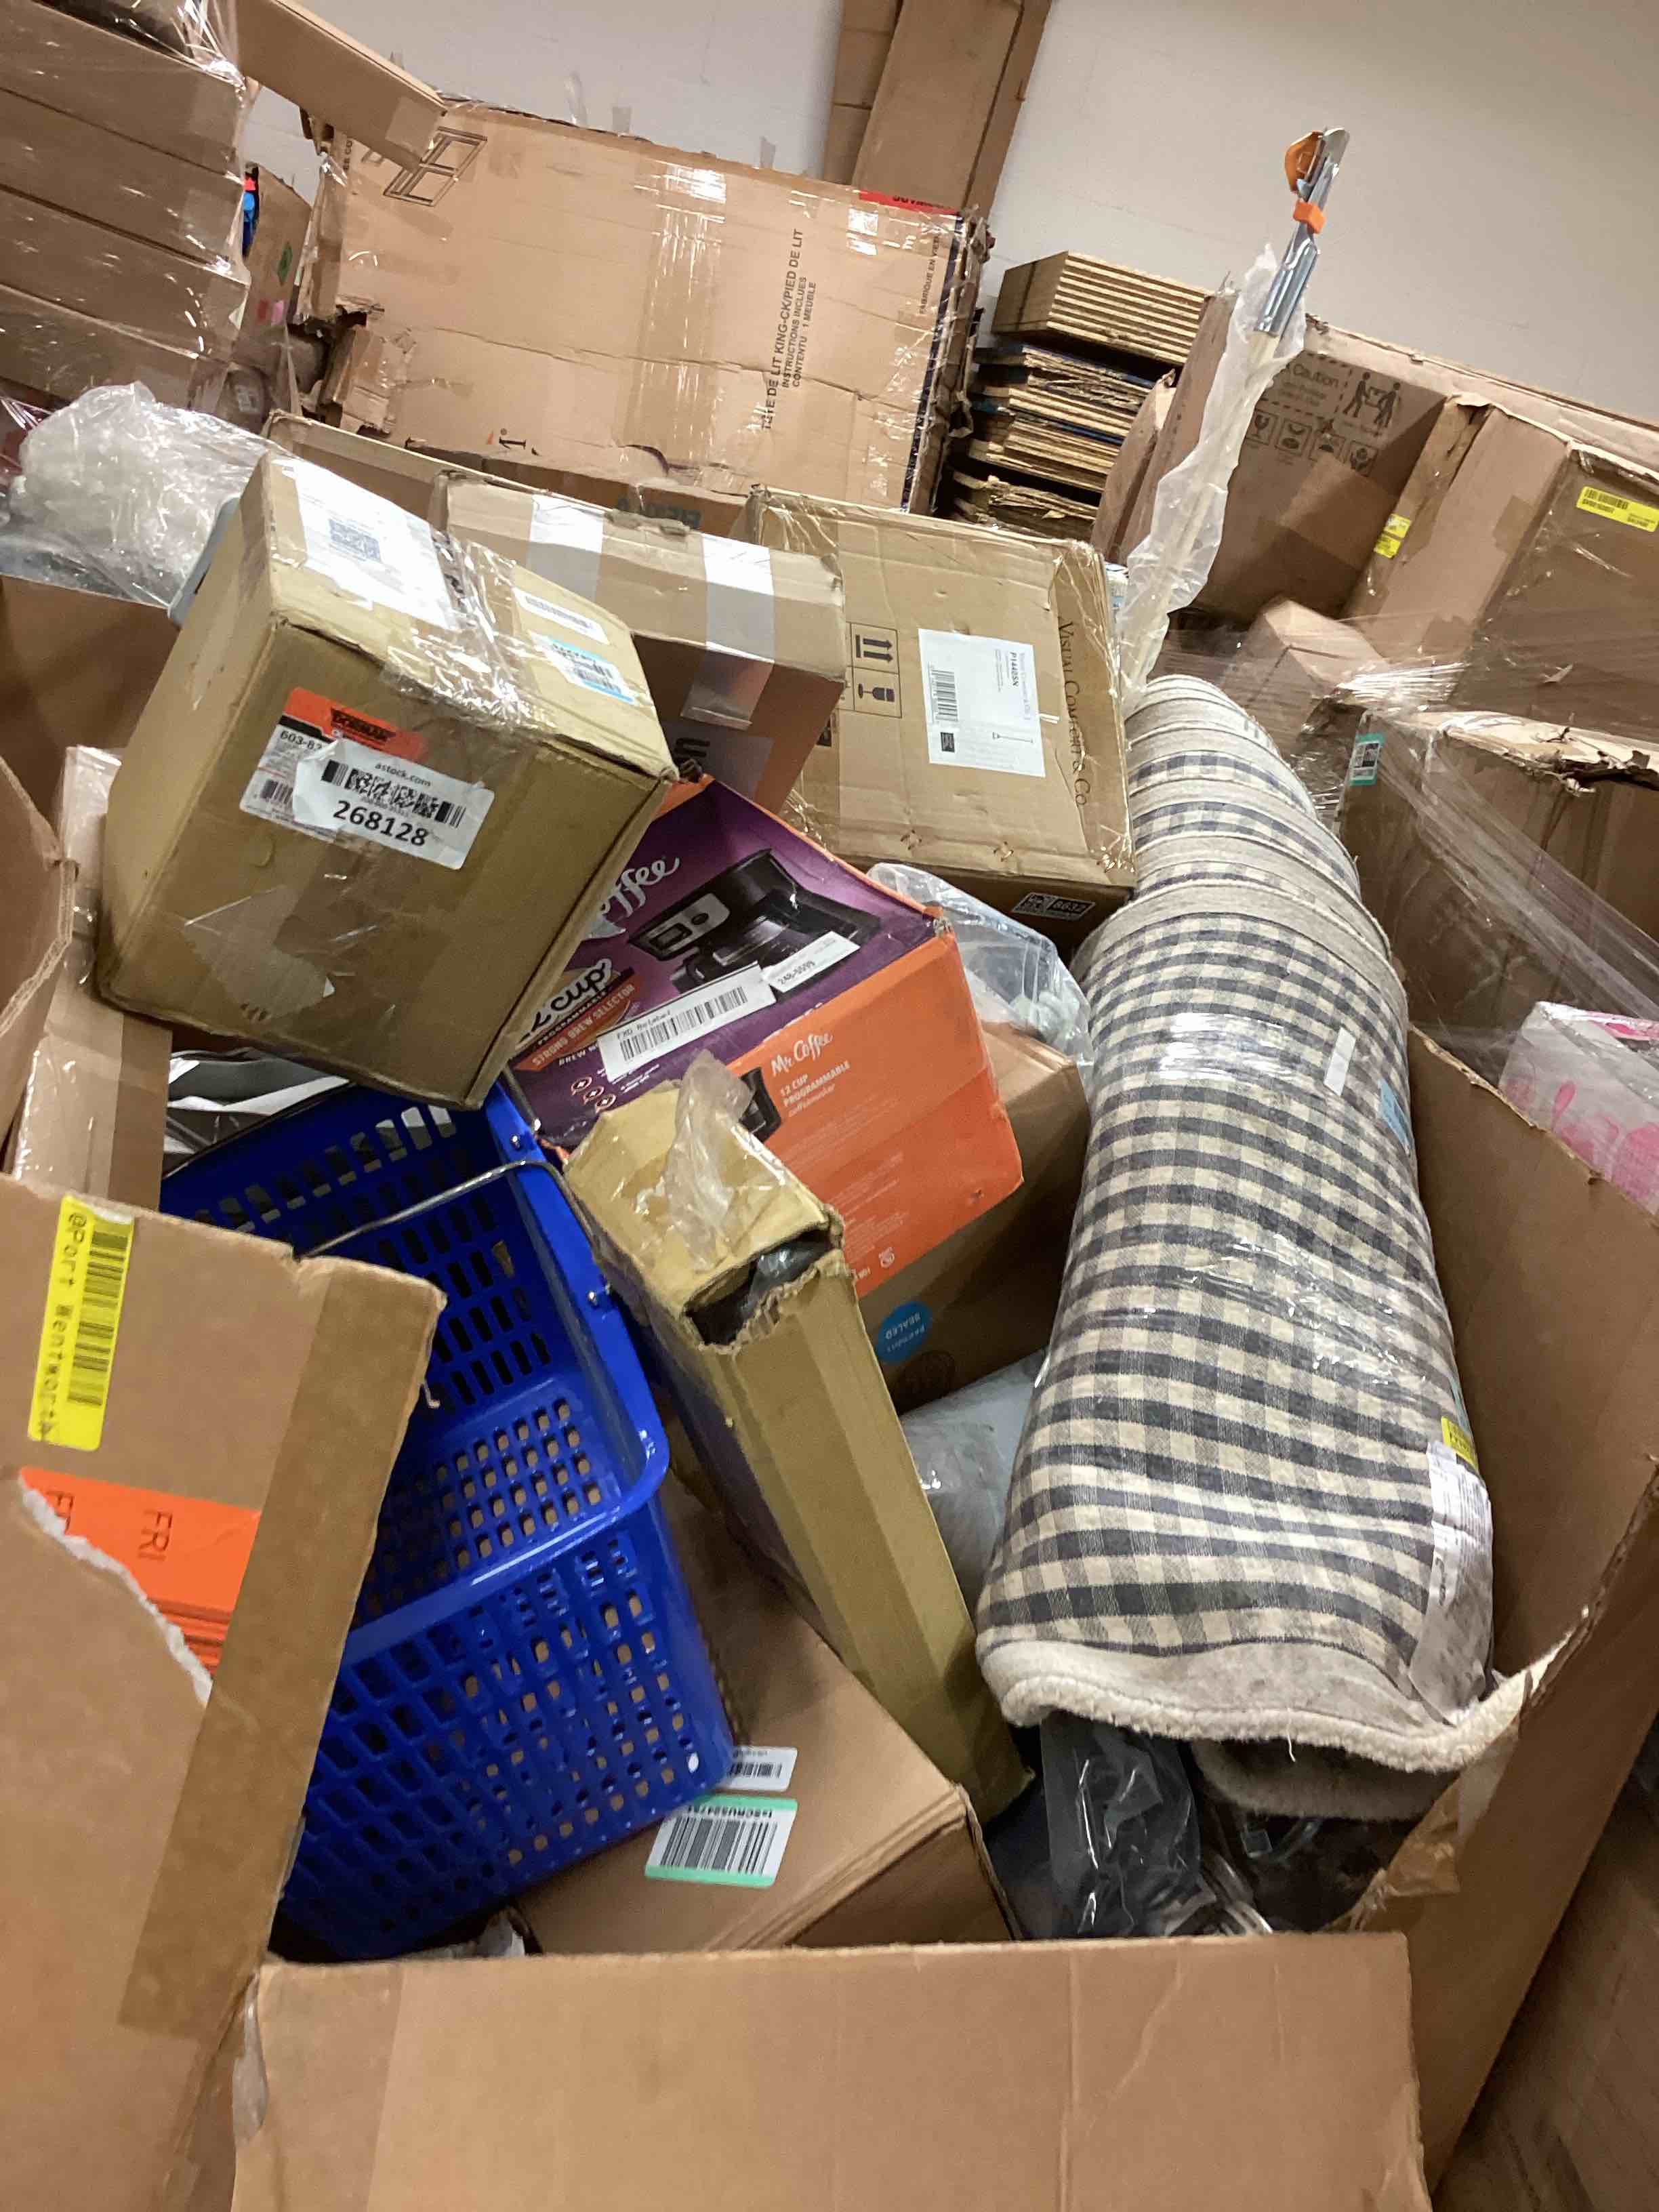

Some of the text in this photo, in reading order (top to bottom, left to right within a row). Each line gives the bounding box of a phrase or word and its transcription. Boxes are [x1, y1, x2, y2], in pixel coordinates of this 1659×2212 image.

[793, 229, 804, 247] LIT
[789, 249, 800, 268] DE
[772, 356, 781, 376] LIT
[768, 379, 779, 397] DE
[333, 800, 430, 848] 268128
[531, 983, 636, 1067] STRONG BREW SELECTOR
[793, 1031, 834, 1062] Coffee
[792, 1073, 808, 1090] CUP
